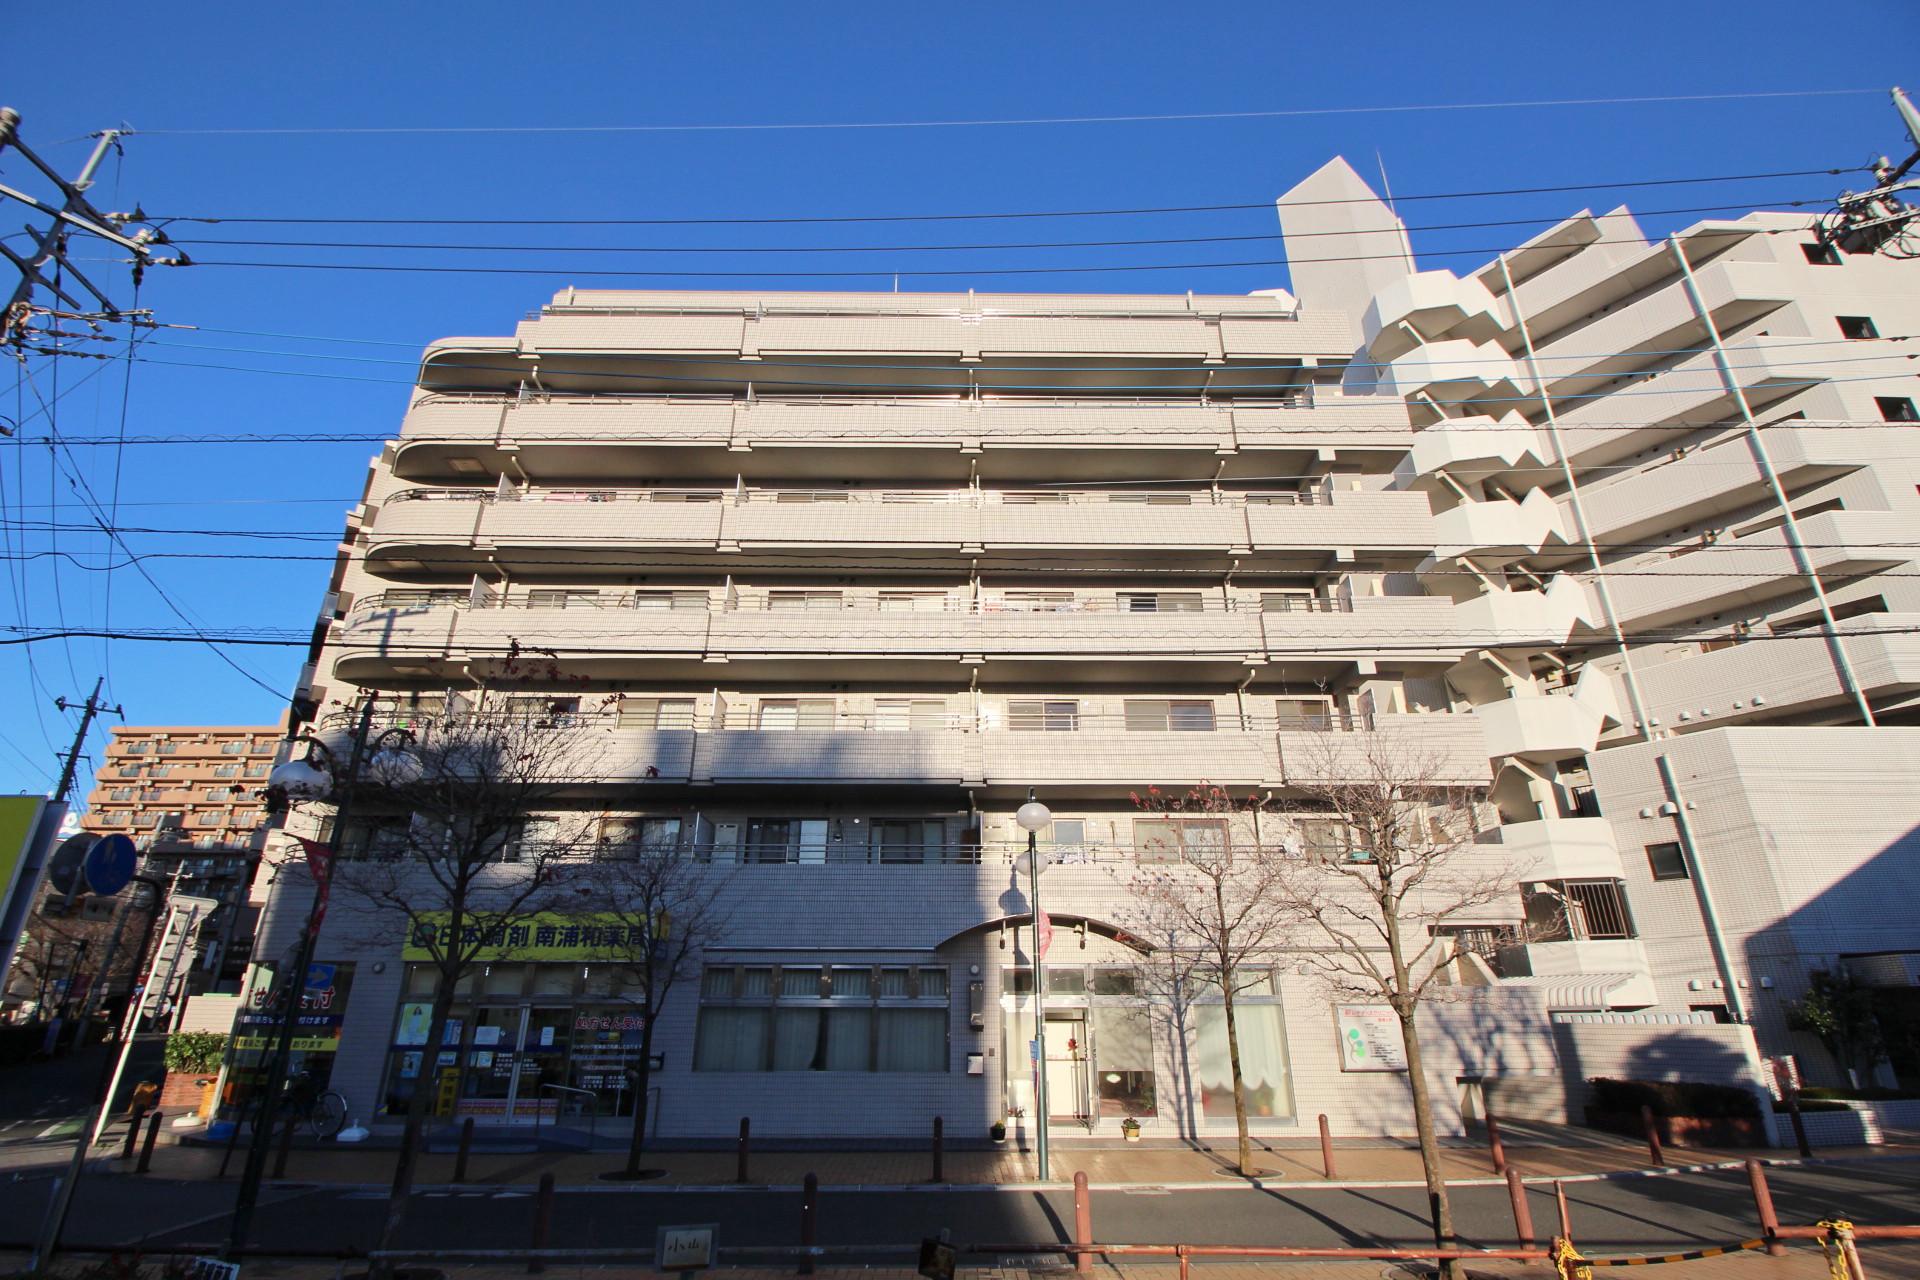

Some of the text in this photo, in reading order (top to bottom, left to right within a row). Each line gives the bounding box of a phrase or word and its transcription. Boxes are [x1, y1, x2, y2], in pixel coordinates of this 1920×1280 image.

[534, 924, 643, 948] 南浦和薬局
